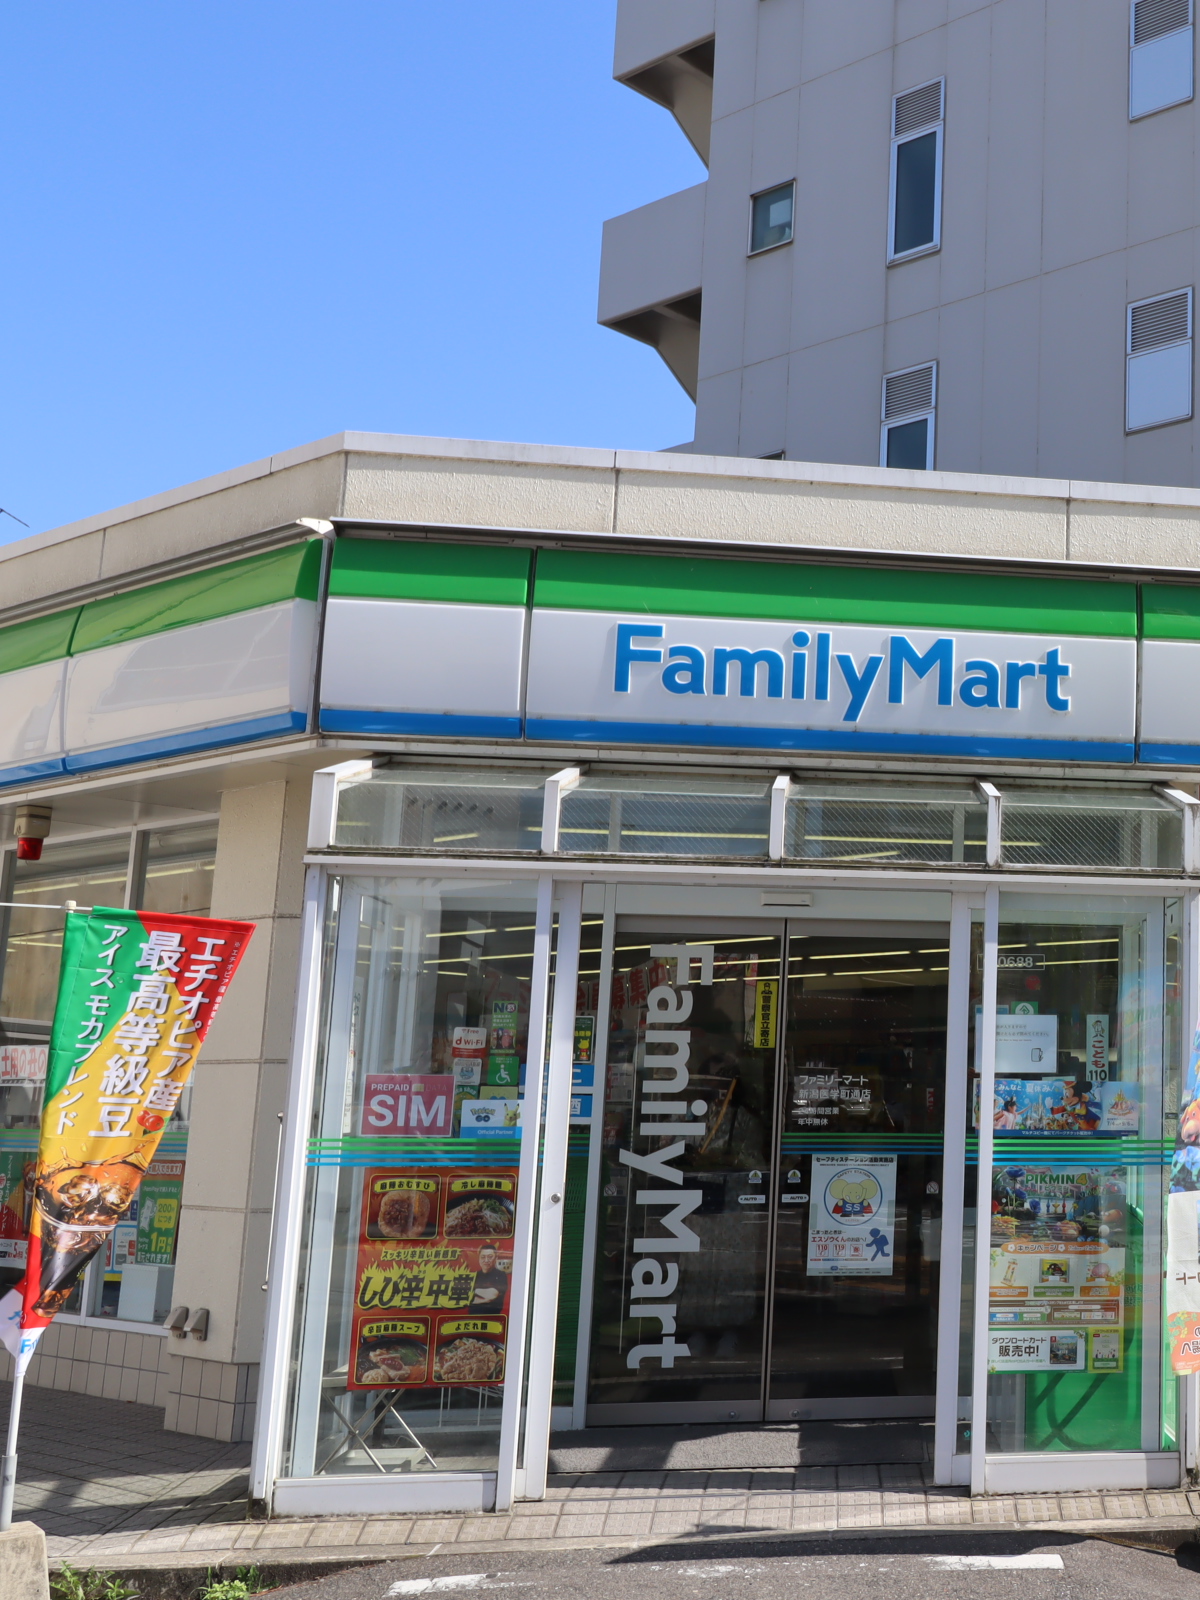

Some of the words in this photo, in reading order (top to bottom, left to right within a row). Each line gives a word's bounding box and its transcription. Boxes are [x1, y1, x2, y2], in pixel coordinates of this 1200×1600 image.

[613, 622, 1072, 722] FamilyMart
[90, 924, 129, 989] アイス
[998, 956, 1034, 968] 0688
[143, 936, 226, 1112] エチオピア産
[759, 995, 772, 1047] 警察官立寄店
[88, 931, 186, 1138] 最高等級豆
[1091, 1039, 1106, 1069] こども
[57, 995, 111, 1136] モカブレンド
[799, 1074, 869, 1086] ファミリーマート
[1088, 1069, 1107, 1081] 110
[371, 1083, 409, 1091] PREPAID
[799, 1089, 871, 1100] 新潟医学町通店
[368, 1094, 447, 1127] SIM
[475, 1114, 491, 1122] GO
[797, 1118, 828, 1126] 年中無休
[619, 944, 714, 1369] FamilyMart
[837, 1170, 853, 1179] SAFETY
[854, 1169, 872, 1179] STATION
[1025, 1173, 1075, 1185] PIKMIN
[1076, 1172, 1088, 1186] 4
[845, 1203, 860, 1211] SS
[359, 1274, 475, 1307] しび辛中華
[991, 1337, 1047, 1345] ダウンロードカード
[998, 1345, 1039, 1357] 販売中!
